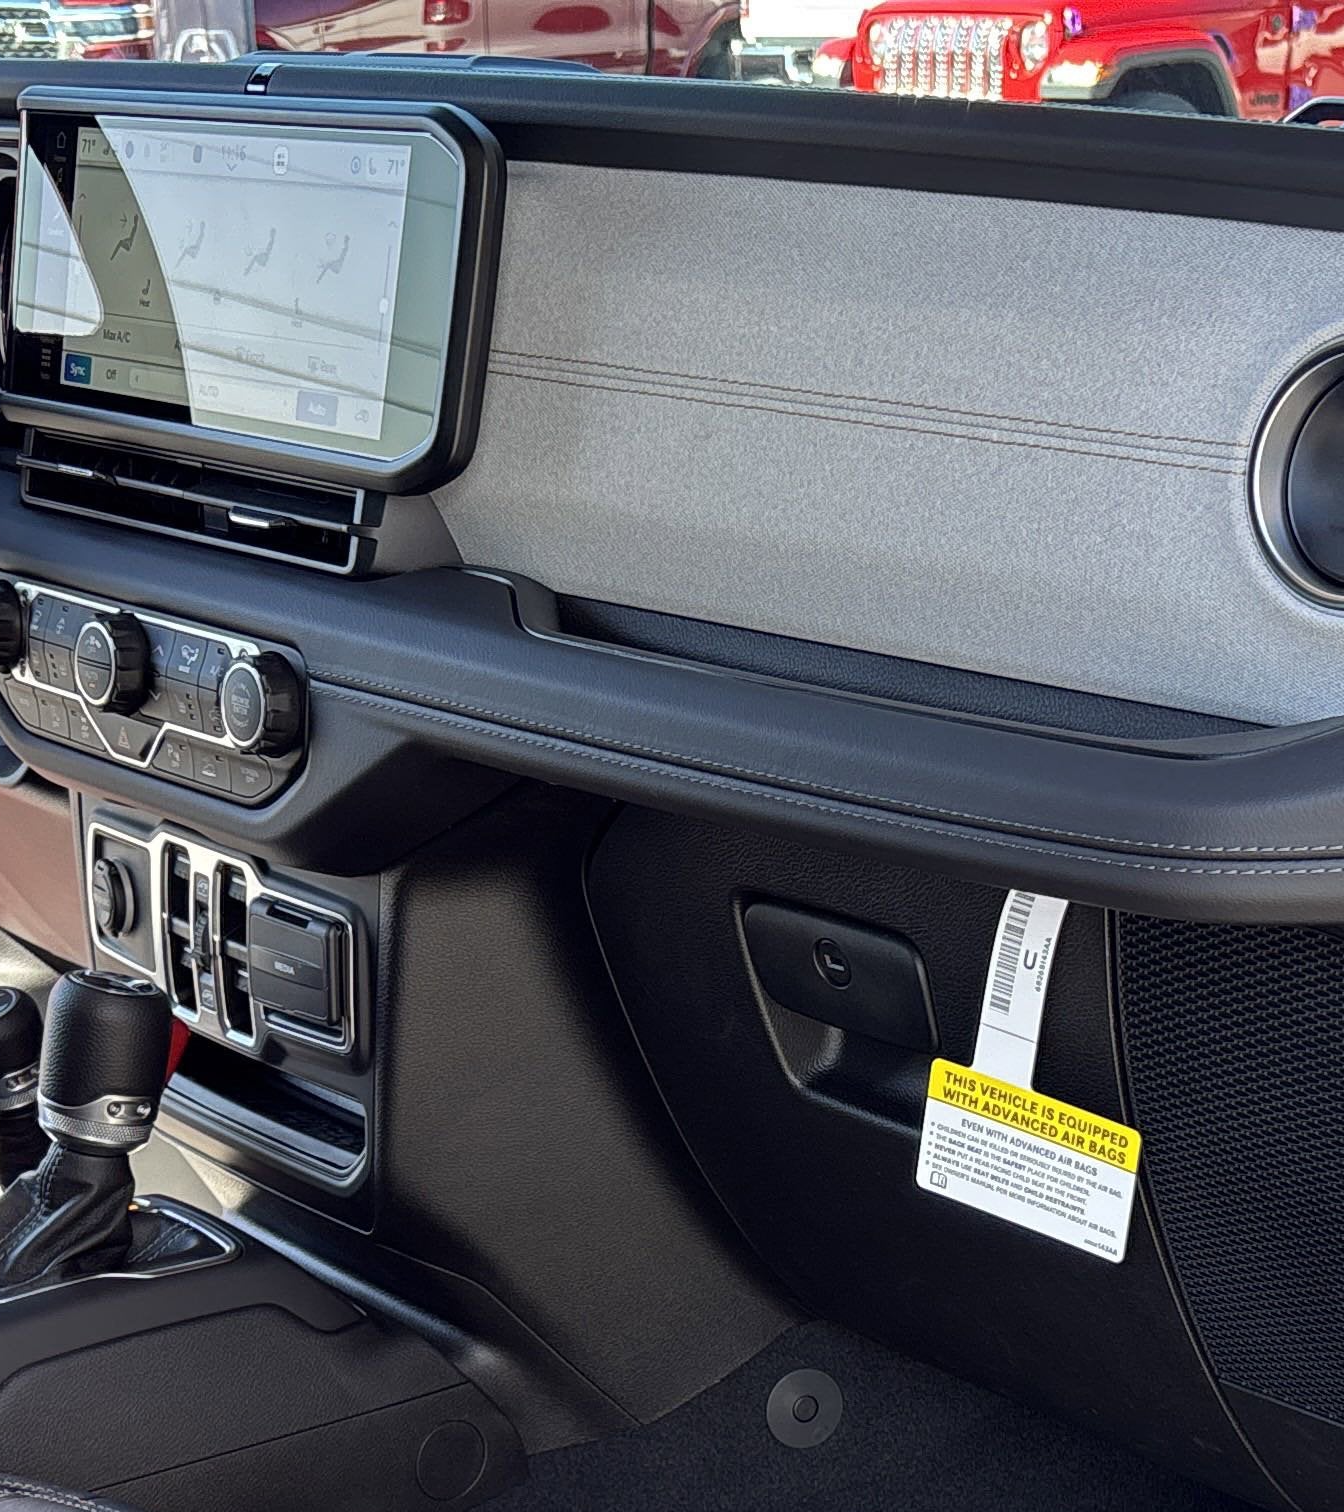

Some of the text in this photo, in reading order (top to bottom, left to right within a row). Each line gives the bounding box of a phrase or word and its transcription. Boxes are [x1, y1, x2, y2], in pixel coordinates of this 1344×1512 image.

[69, 363, 86, 377] Sync
[105, 368, 117, 380] Off
[943, 1087, 1126, 1163] WITH ADVANCED AIR BAGS
[944, 1071, 1129, 1148] THIS VEHICLE IS EQUIPPED
[935, 1143, 956, 1154] NEVER
[956, 1151, 968, 1159] PUT
[948, 1138, 965, 1148] BACK
[967, 1144, 982, 1154] SEAT
[1003, 1158, 1026, 1170] SAFEST
[1027, 1167, 1045, 1178] PLACE
[961, 1119, 1098, 1176] EVEN WITH ADVANCED AIR BAGS
[933, 1153, 959, 1166] ALWAYS
[973, 1168, 989, 1177] SEAT
